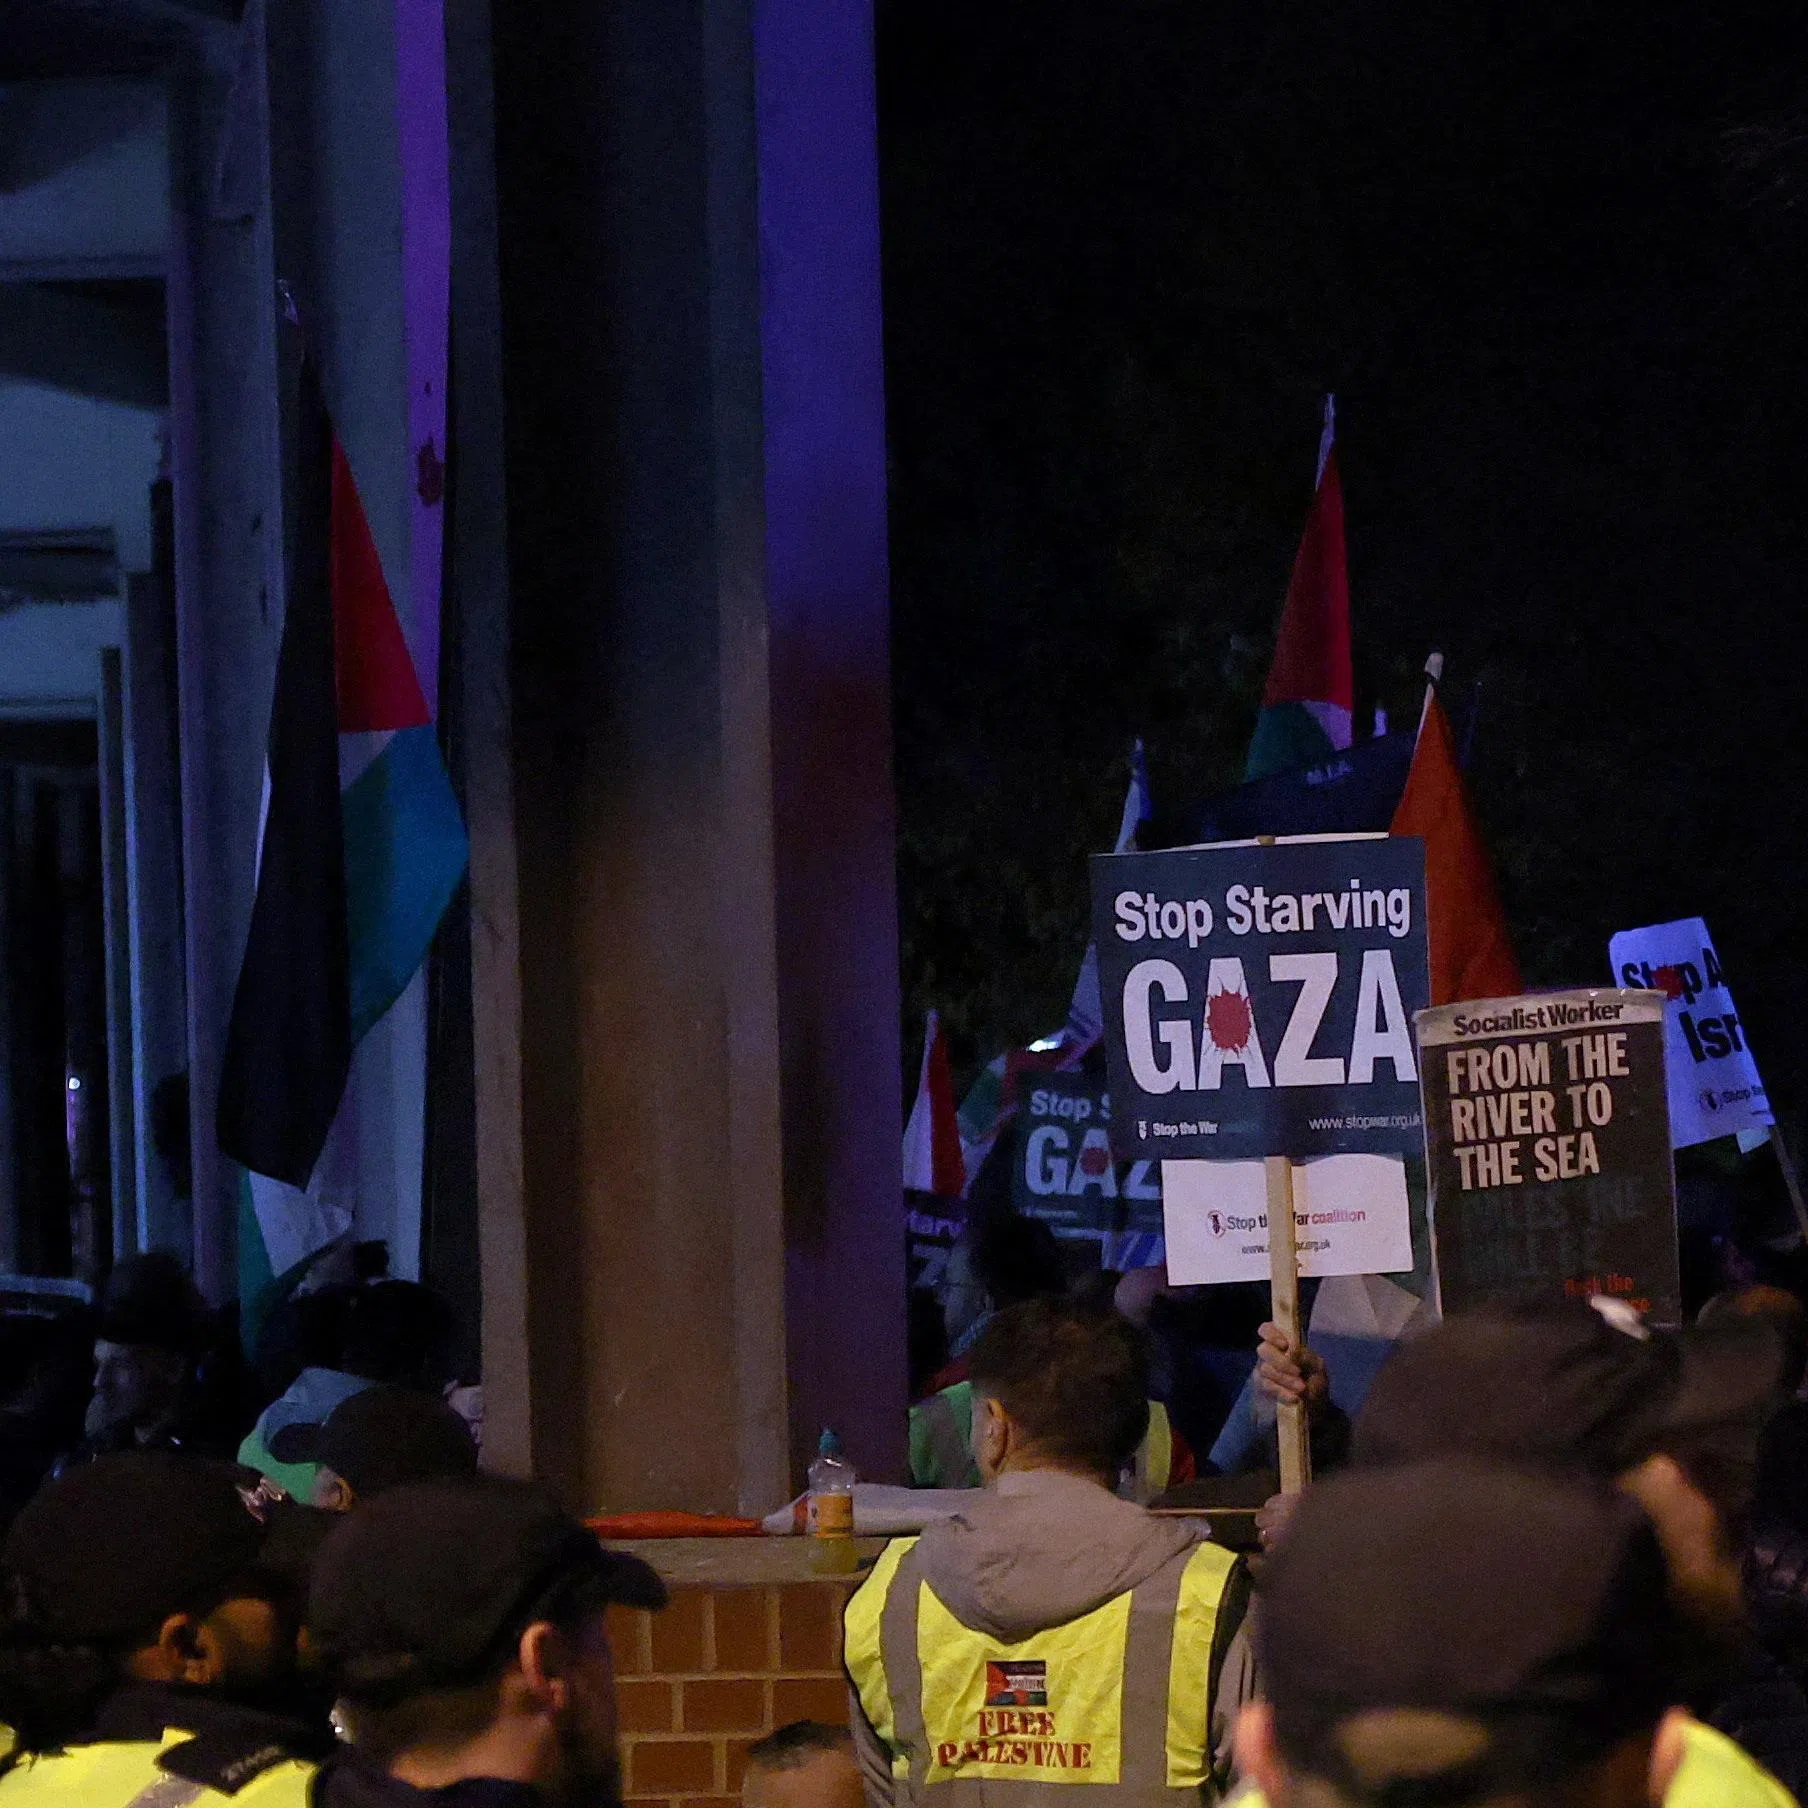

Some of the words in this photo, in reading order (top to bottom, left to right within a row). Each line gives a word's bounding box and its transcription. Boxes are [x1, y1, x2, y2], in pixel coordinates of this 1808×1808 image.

[1115, 891, 1213, 948] Stop
[1226, 879, 1410, 937] Starving
[1123, 949, 1418, 1094] GAZA
[1453, 1007, 1547, 1037] Socialist
[1547, 1001, 1623, 1026] Worker
[1448, 1041, 1550, 1094] FROM
[1562, 1032, 1630, 1081] THE
[1030, 1089, 1091, 1122] Stop
[1451, 1090, 1557, 1143] RIVER
[1566, 1081, 1613, 1128] TO
[1153, 1122, 1179, 1138] Stop
[1180, 1121, 1198, 1135] the
[1199, 1121, 1218, 1135] War
[1453, 1141, 1523, 1190] THE
[1534, 1131, 1600, 1182] SEA
[1227, 1214, 1257, 1231] Stop
[1312, 1210, 1366, 1224] coalition
[978, 1711, 1057, 1737] FREE
[938, 1740, 1092, 1768] PALESTINE
